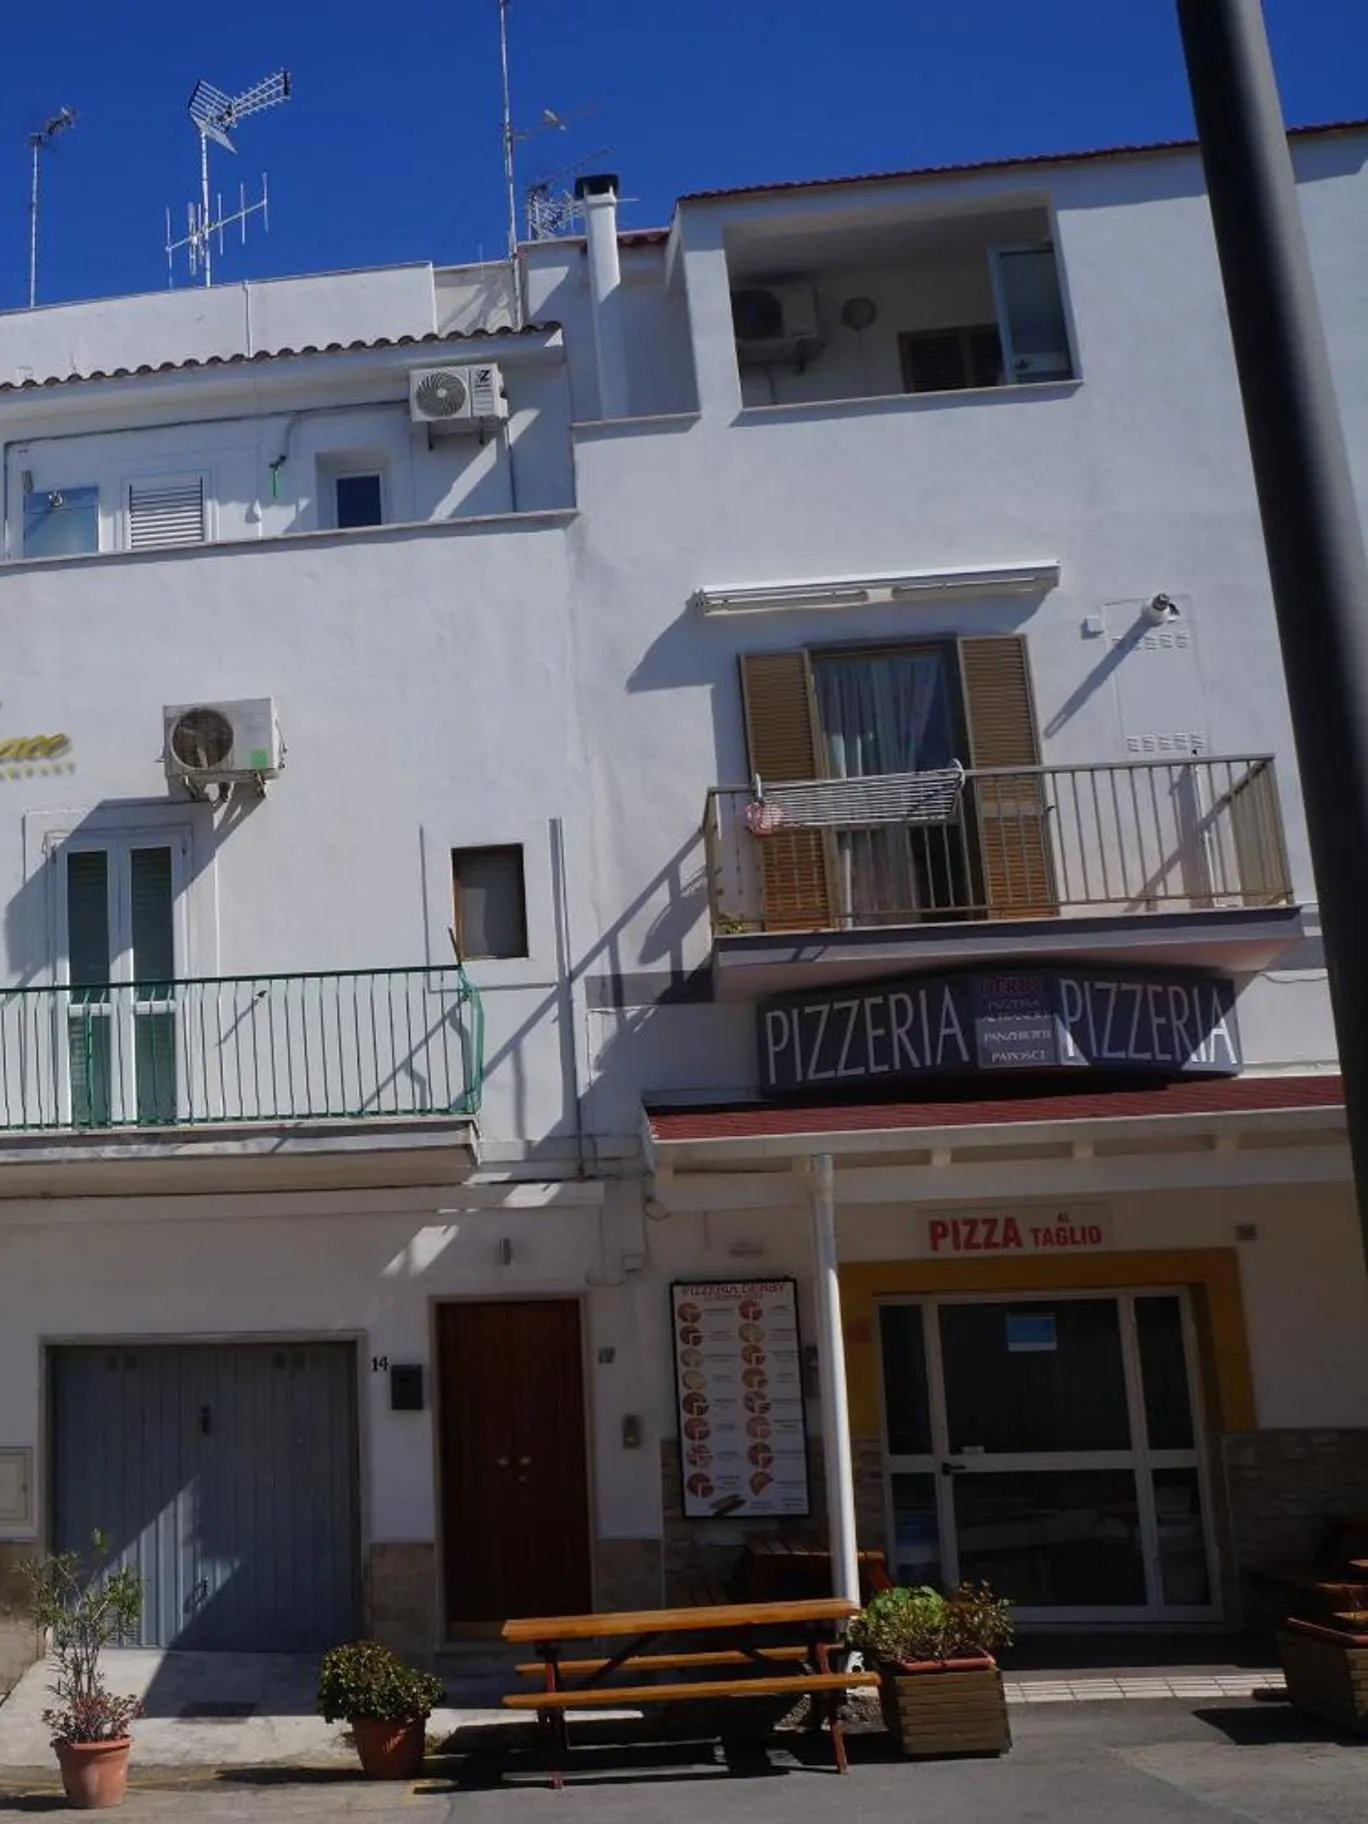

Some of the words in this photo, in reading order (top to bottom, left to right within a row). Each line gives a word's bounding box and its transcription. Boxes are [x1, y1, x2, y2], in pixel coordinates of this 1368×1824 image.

[765, 985, 970, 1085] PIZZERIA
[1059, 979, 1238, 1066] PIZZERIA
[929, 1217, 1022, 1251] PIZZA
[1030, 1225, 1103, 1248] TAGLIO
[371, 1356, 389, 1372] 14
